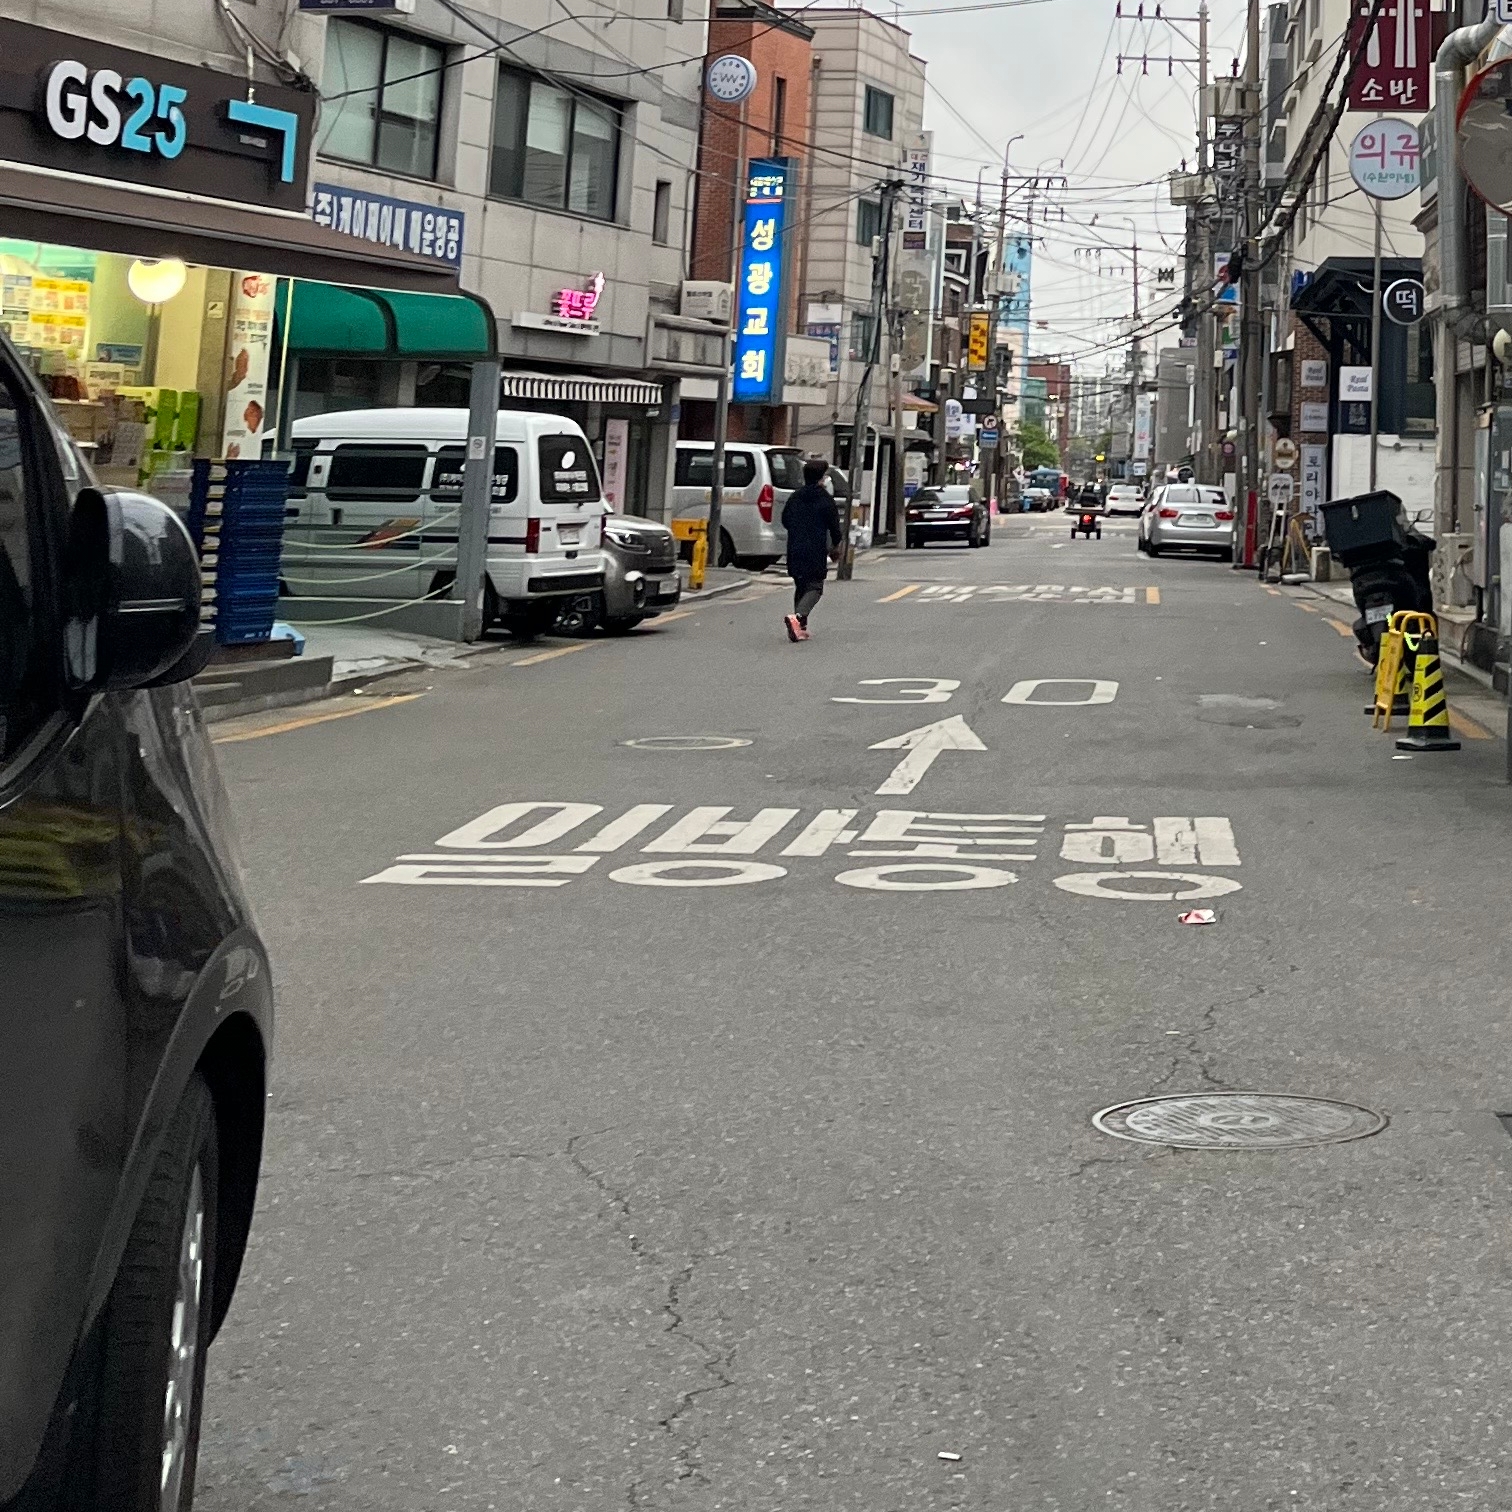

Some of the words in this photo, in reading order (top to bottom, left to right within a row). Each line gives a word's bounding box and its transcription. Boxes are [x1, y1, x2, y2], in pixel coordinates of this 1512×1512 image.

[46, 59, 188, 159] GS25
[1361, 77, 1419, 105] 소반
[1355, 133, 1421, 170] 의류
[741, 219, 775, 382] 성광교회
[1395, 289, 1417, 315] 떡
[830, 677, 1119, 706] 30
[358, 801, 1243, 901] 일방통행
